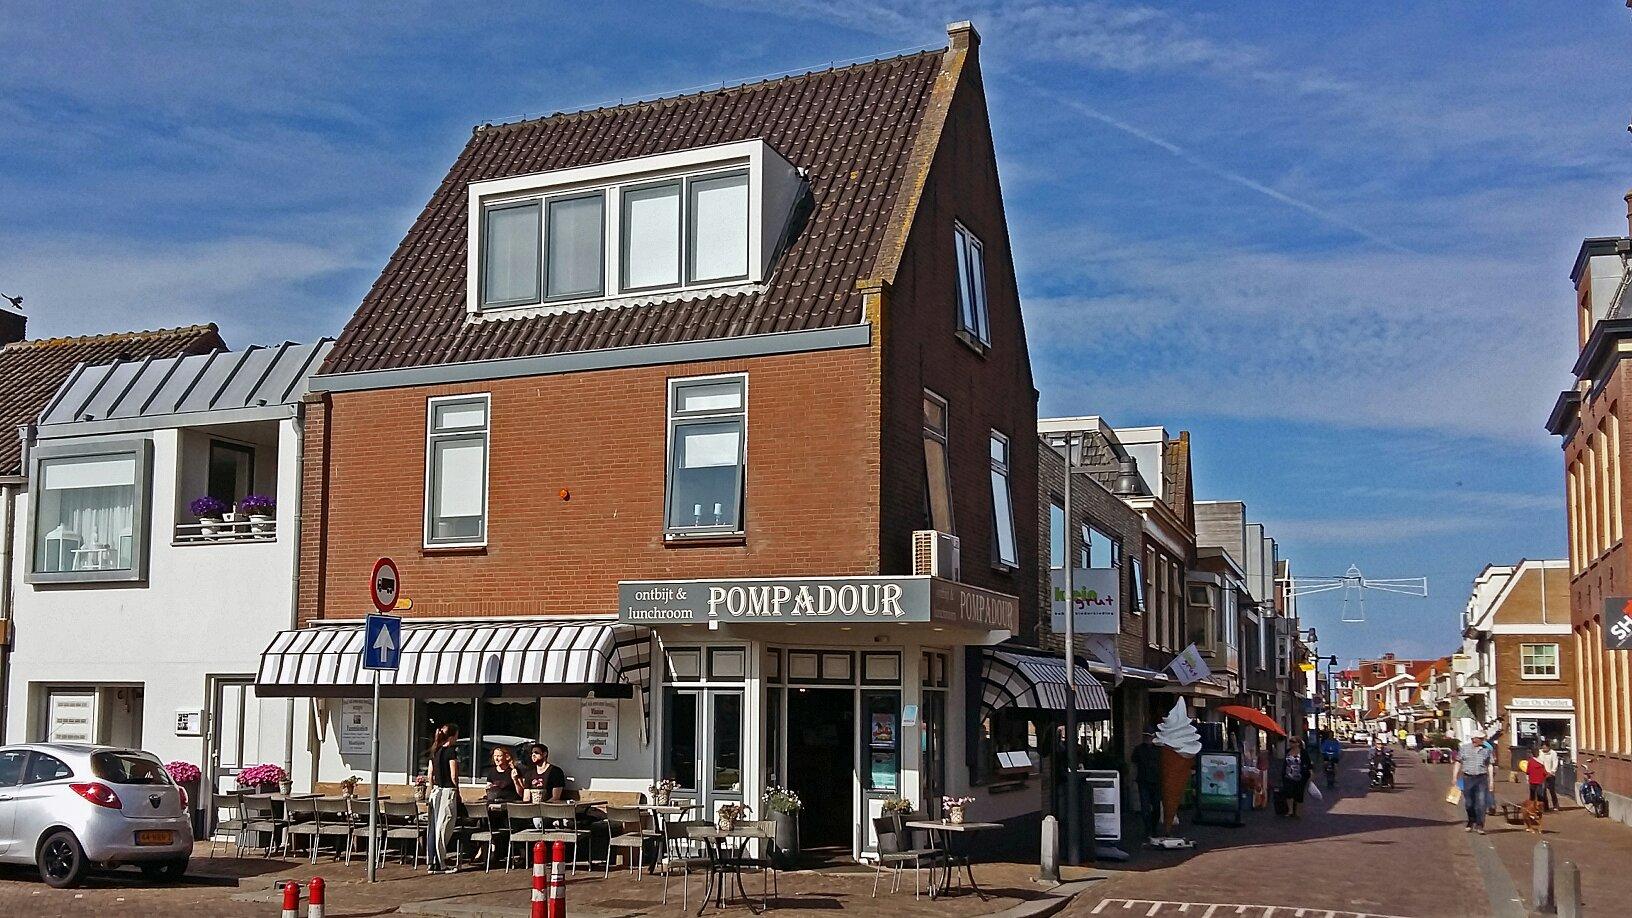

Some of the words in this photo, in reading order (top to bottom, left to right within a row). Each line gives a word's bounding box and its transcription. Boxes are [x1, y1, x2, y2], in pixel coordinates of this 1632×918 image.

[634, 587, 673, 604] ontbijt
[676, 587, 687, 600] &
[707, 583, 906, 619] POMPADOUR
[1075, 594, 1114, 610] grut
[627, 606, 694, 620] lunchroom
[960, 590, 1013, 630] POMPADOUR
